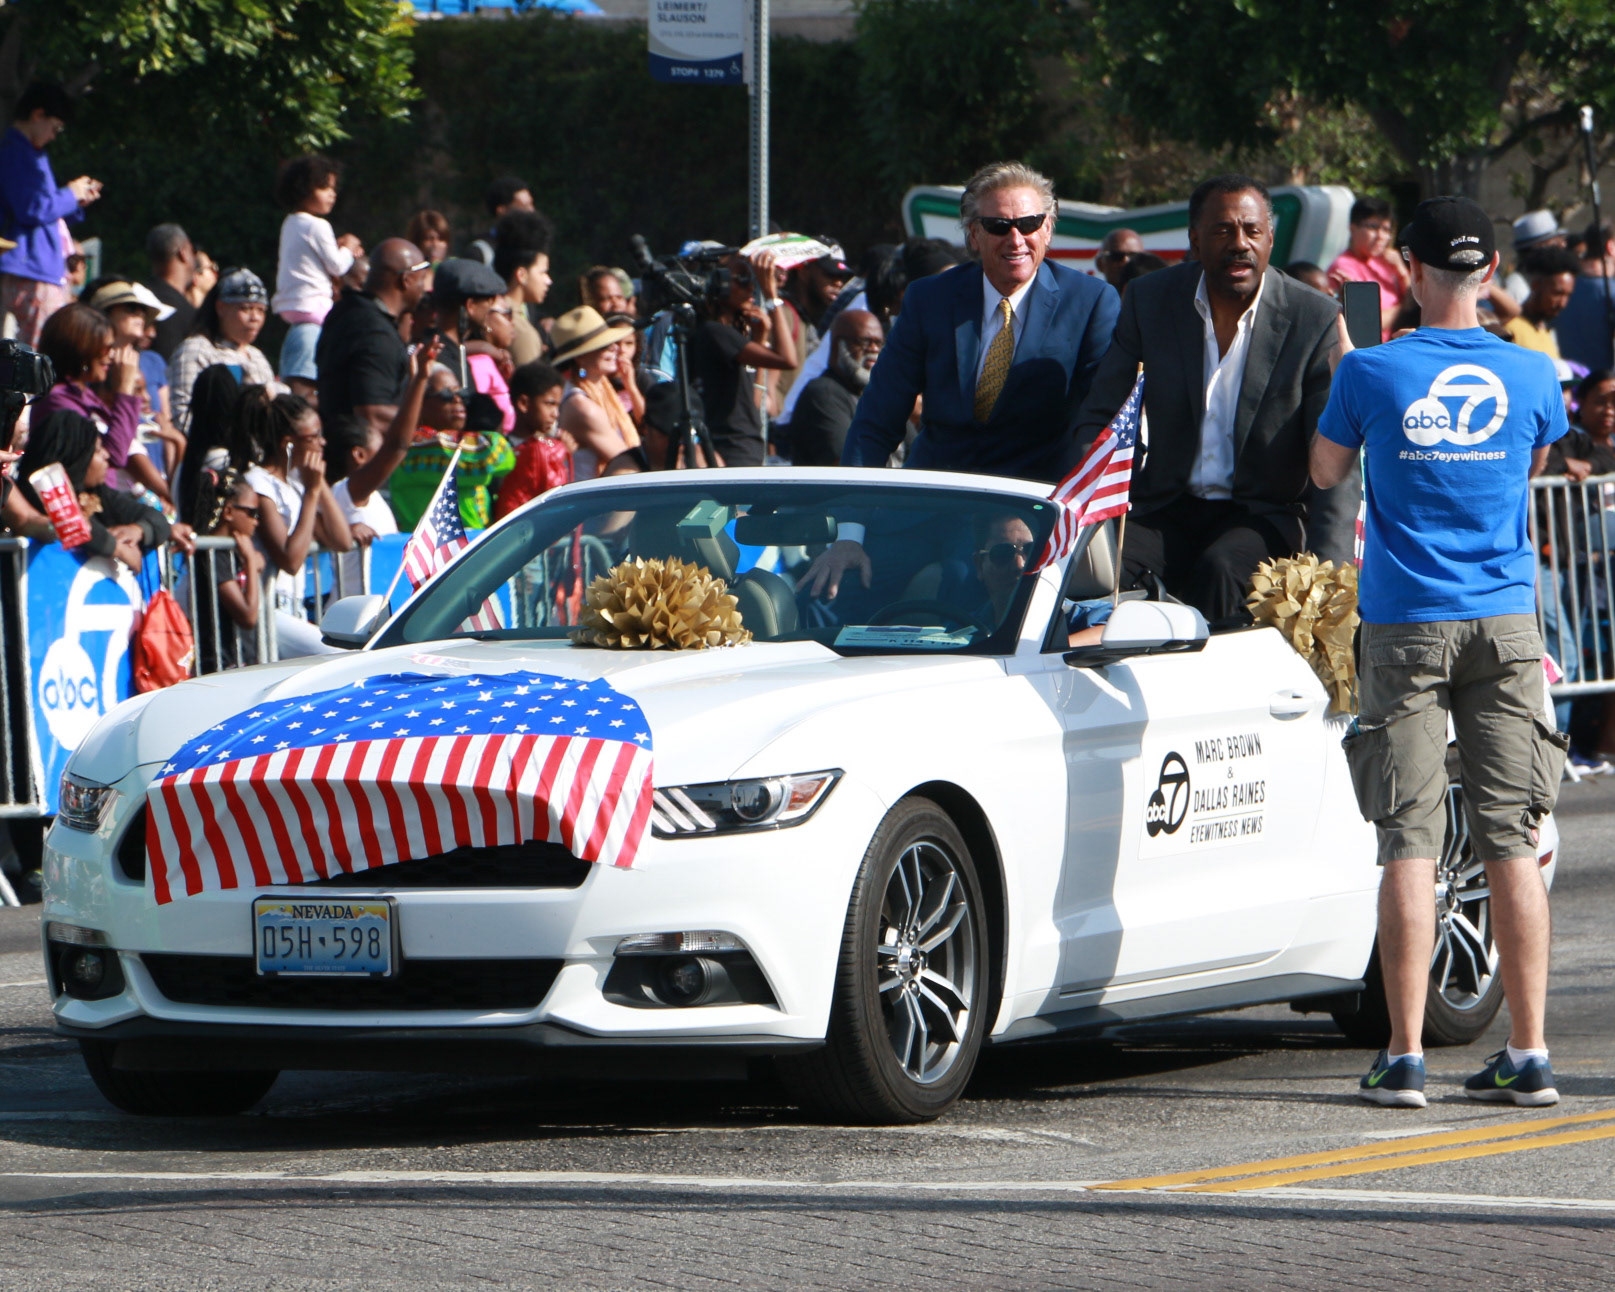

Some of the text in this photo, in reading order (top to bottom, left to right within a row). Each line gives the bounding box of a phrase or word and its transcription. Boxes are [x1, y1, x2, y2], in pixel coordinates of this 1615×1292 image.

[657, 2, 707, 11] LEIMERT/
[657, 13, 706, 23] SLAUSON
[1450, 235, 1479, 247] abc7.com
[1404, 410, 1449, 430] abc
[1399, 450, 1506, 463] #abc7eyewitness
[43, 665, 97, 710] abc
[1195, 732, 1262, 764] MARC BROWN
[1227, 766, 1234, 779] &
[1194, 780, 1265, 813] DALLAS RAINES
[1146, 801, 1166, 823] abc
[1190, 815, 1263, 843] EYEWITNESS NEWS
[292, 905, 354, 919] NEVADA
